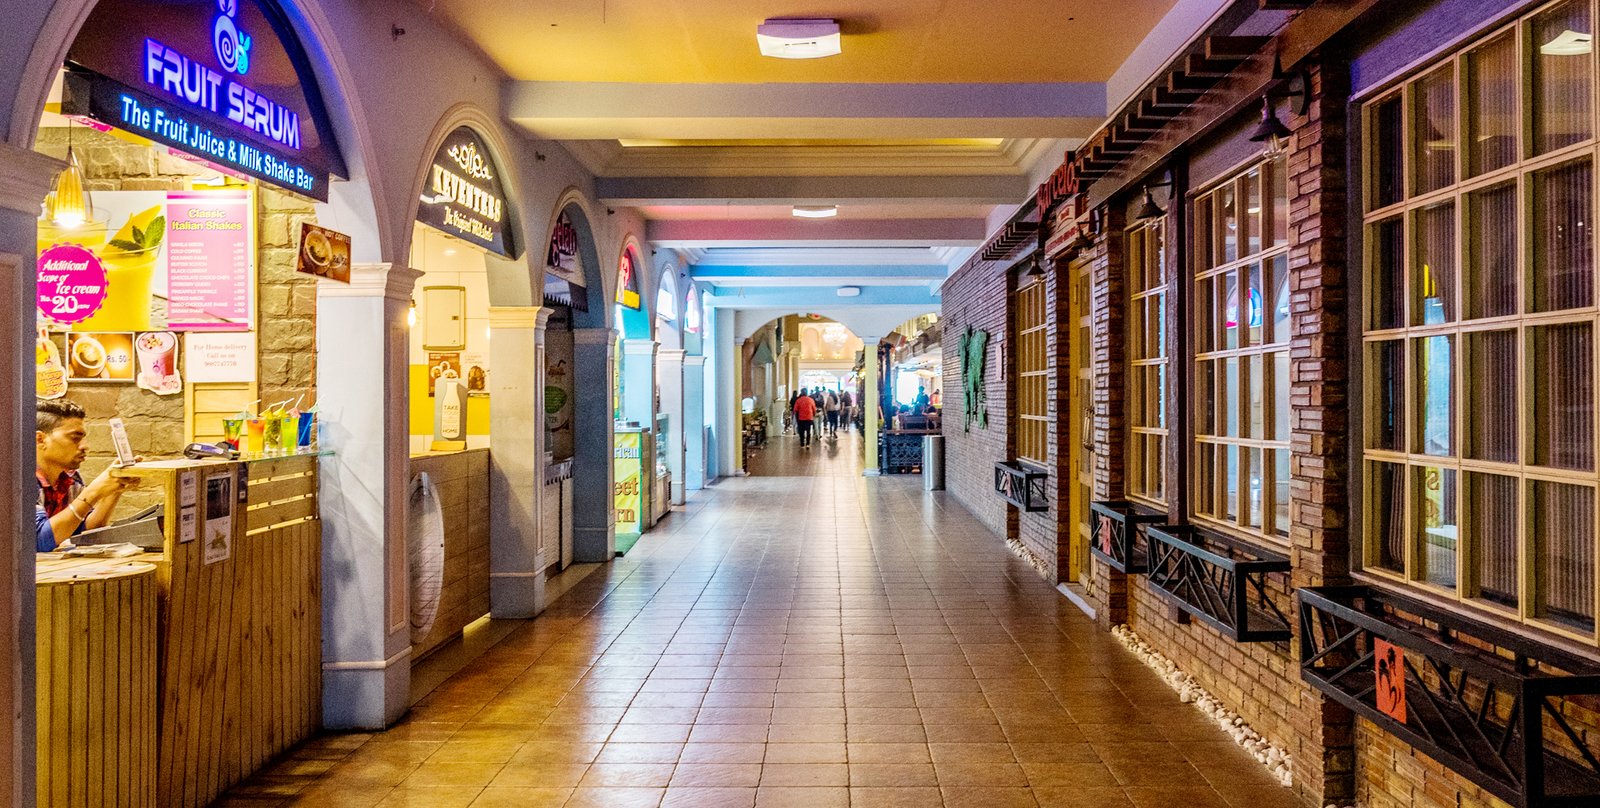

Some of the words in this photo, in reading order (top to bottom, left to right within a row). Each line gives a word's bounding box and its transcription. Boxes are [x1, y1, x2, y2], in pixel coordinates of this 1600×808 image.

[147, 38, 223, 112] FRUIT
[227, 81, 300, 150] SERUM
[122, 96, 150, 130] The
[154, 109, 188, 145] Fruit
[190, 125, 225, 157] Juice
[228, 139, 237, 163] &
[239, 145, 262, 172] Milk
[264, 154, 295, 184] Shake
[296, 167, 314, 191] Bar
[432, 163, 502, 223] KEVENTERS
[188, 208, 226, 219] Classic
[171, 220, 204, 230] Italian
[205, 220, 243, 230] Shakes
[43, 258, 89, 271] Additional
[37, 272, 59, 283] Scope
[56, 282, 71, 294] Ice
[72, 285, 101, 295] cream
[51, 295, 78, 314] 20
[614, 443, 639, 459] rican
[614, 477, 639, 496] eet
